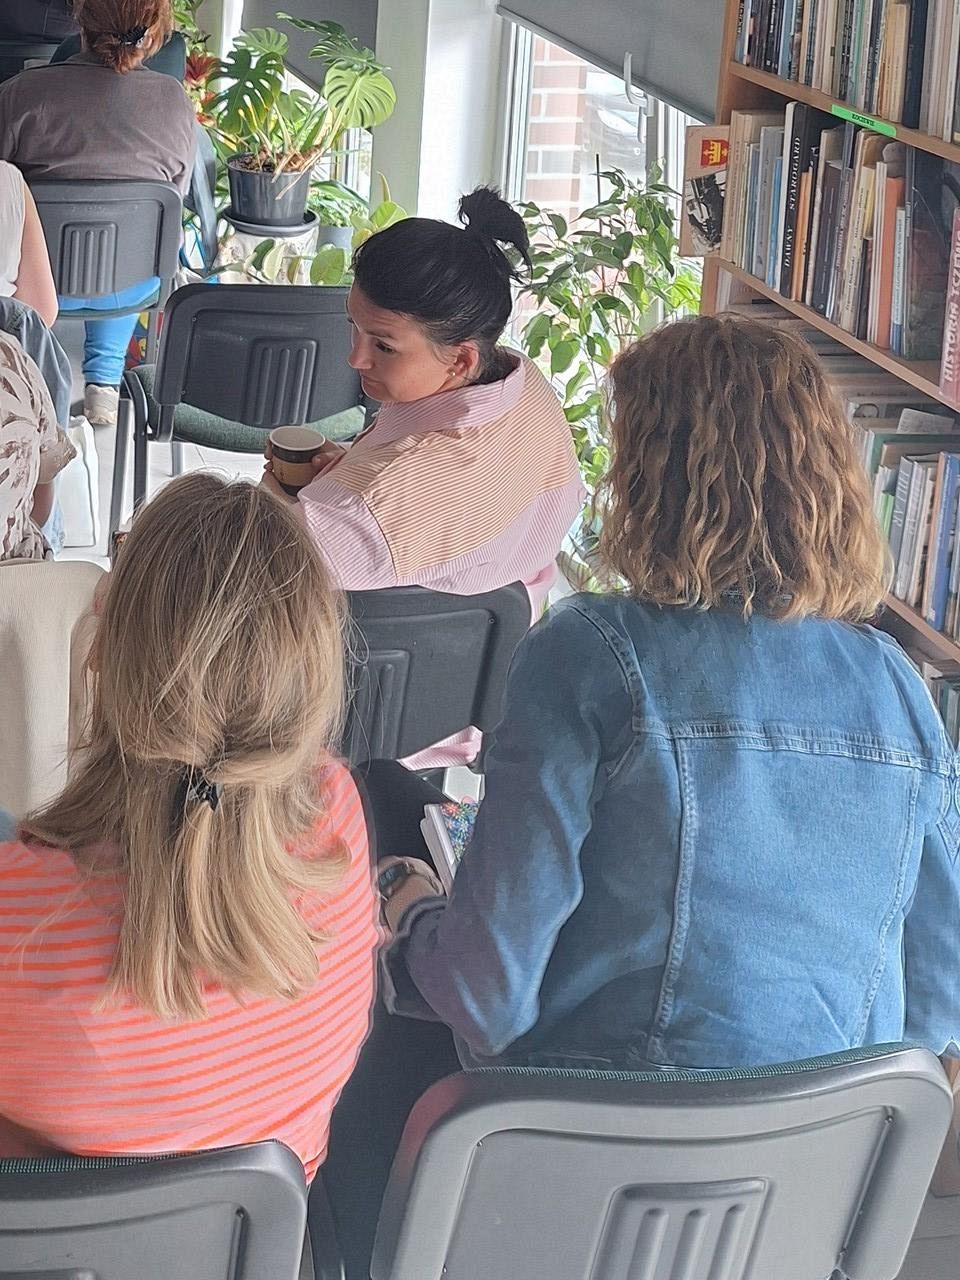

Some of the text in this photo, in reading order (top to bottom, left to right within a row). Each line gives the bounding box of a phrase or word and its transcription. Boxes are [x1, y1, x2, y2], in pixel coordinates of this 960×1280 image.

[784, 136, 802, 268] DAWNY STAROGARD
[943, 302, 959, 383] HISTORIA
